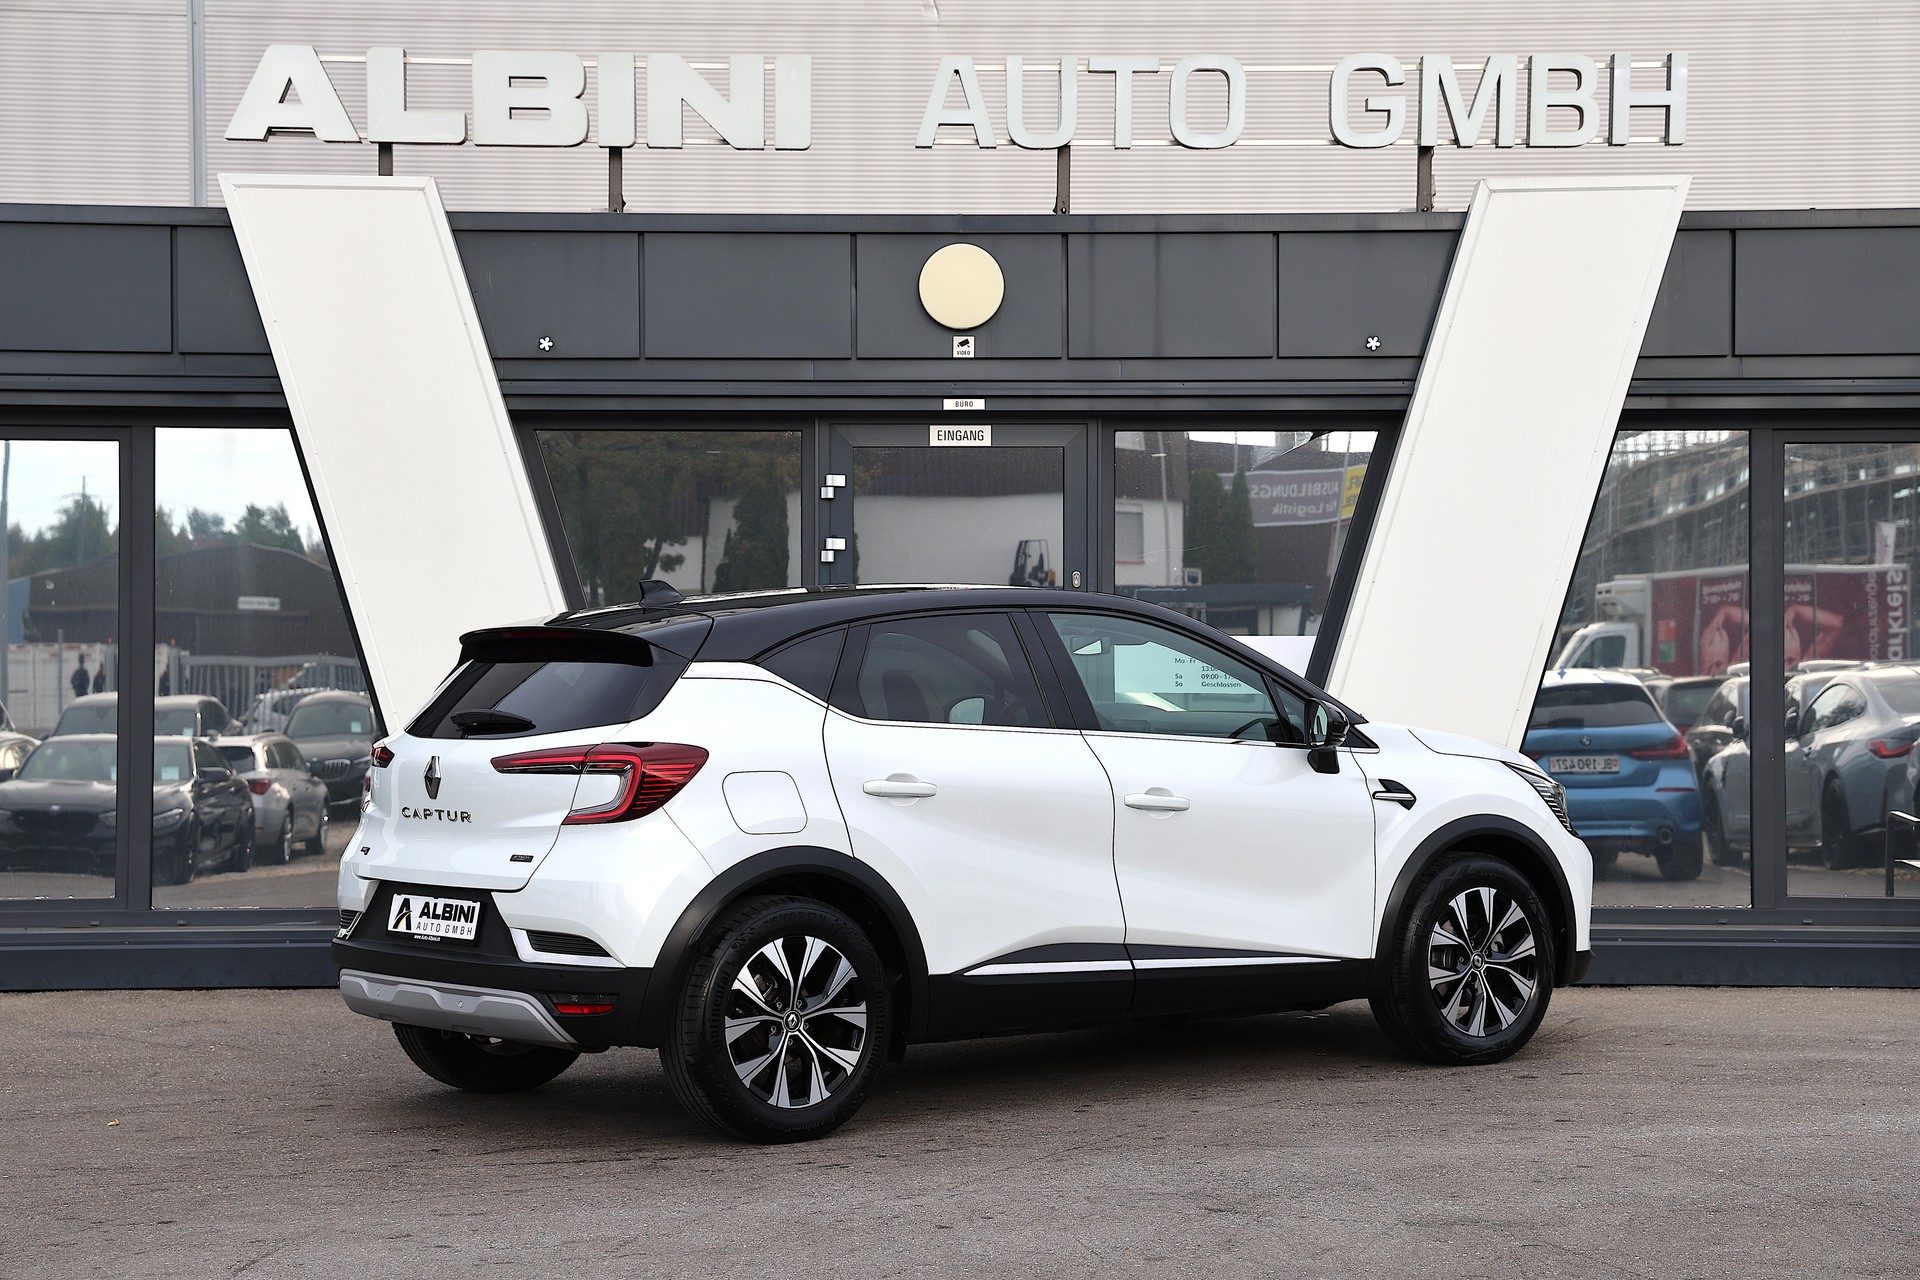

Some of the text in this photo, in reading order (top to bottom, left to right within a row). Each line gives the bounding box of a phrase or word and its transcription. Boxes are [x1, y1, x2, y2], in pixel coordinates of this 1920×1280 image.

[224, 43, 1689, 151] ALBINI AUTO GMBH
[954, 400, 974, 408] BÜRO
[937, 430, 984, 441] EINGANG
[401, 806, 472, 823] CAPTUR
[418, 901, 476, 924] ALBINI
[415, 922, 473, 936] AUTO GMBH
